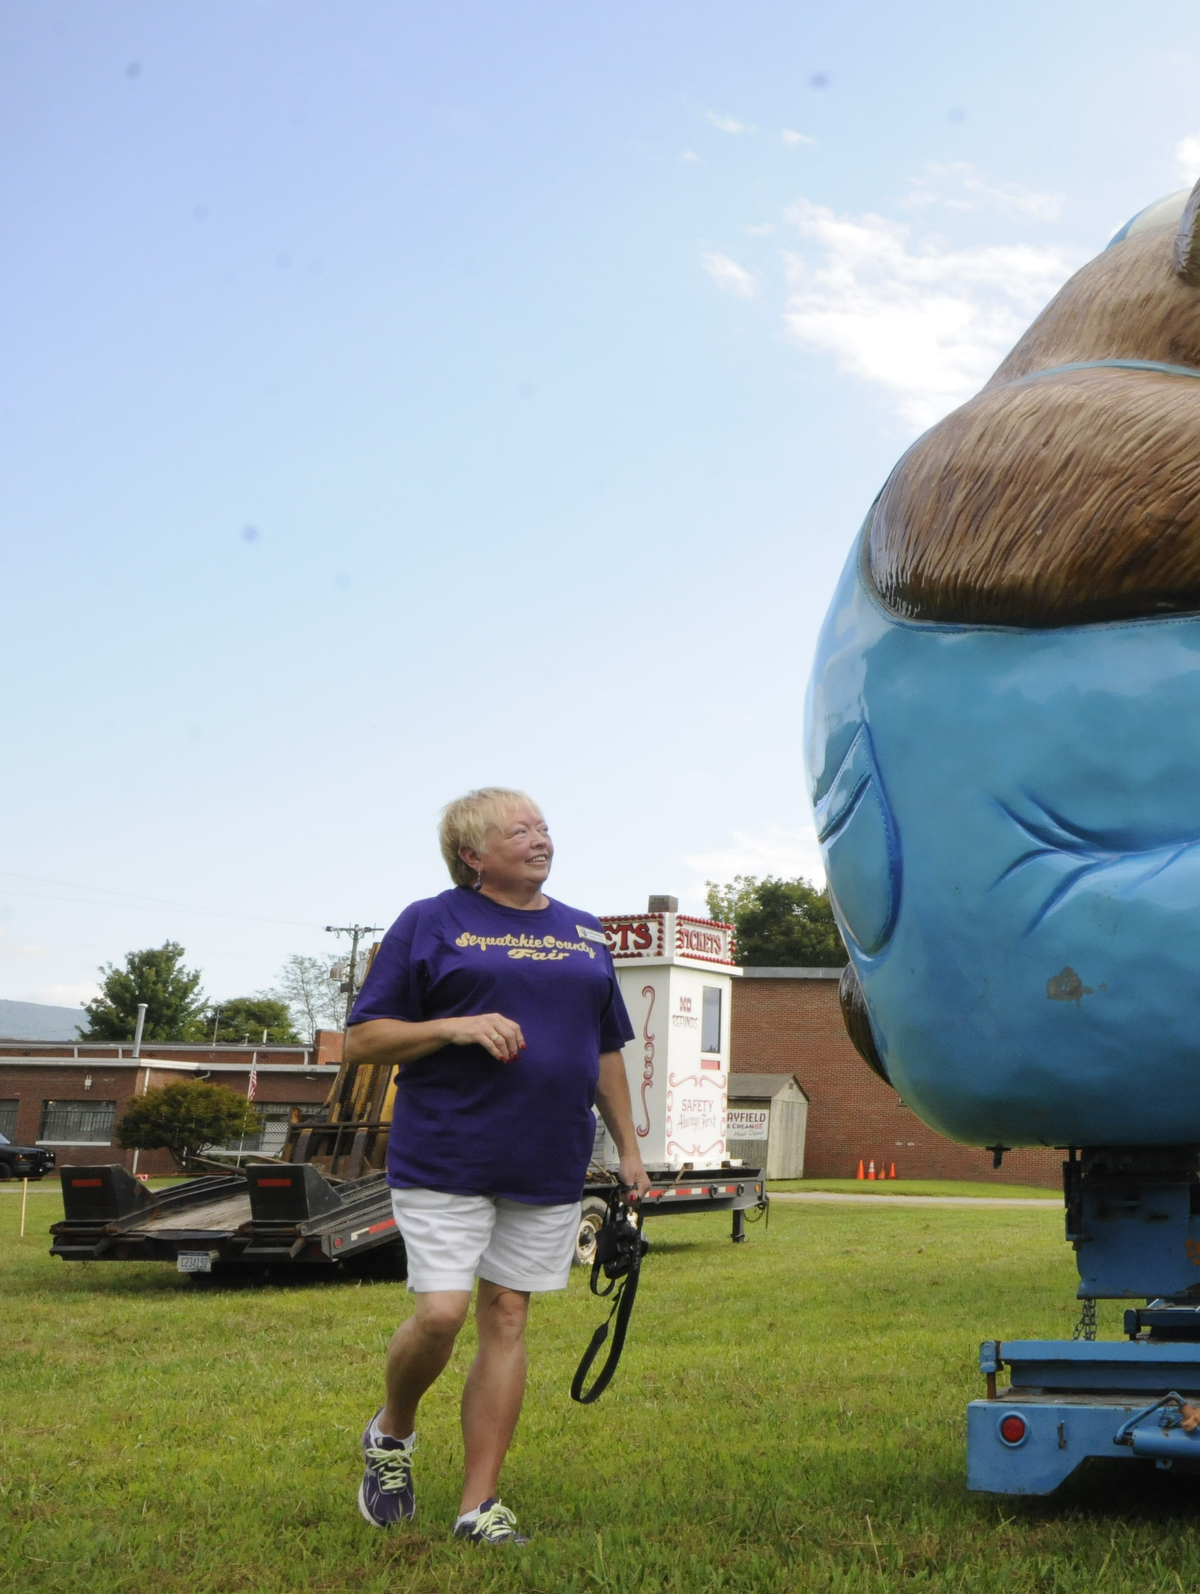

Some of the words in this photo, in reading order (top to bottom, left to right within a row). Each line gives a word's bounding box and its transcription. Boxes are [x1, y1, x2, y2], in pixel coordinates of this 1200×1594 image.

[455, 932, 544, 951] Sequatchie
[543, 935, 596, 959] County
[680, 928, 722, 955] TICKETS
[507, 948, 570, 960] Fair
[679, 996, 692, 1012] NO
[672, 1014, 698, 1029] REFUNDS
[681, 1098, 713, 1112] SAFETY
